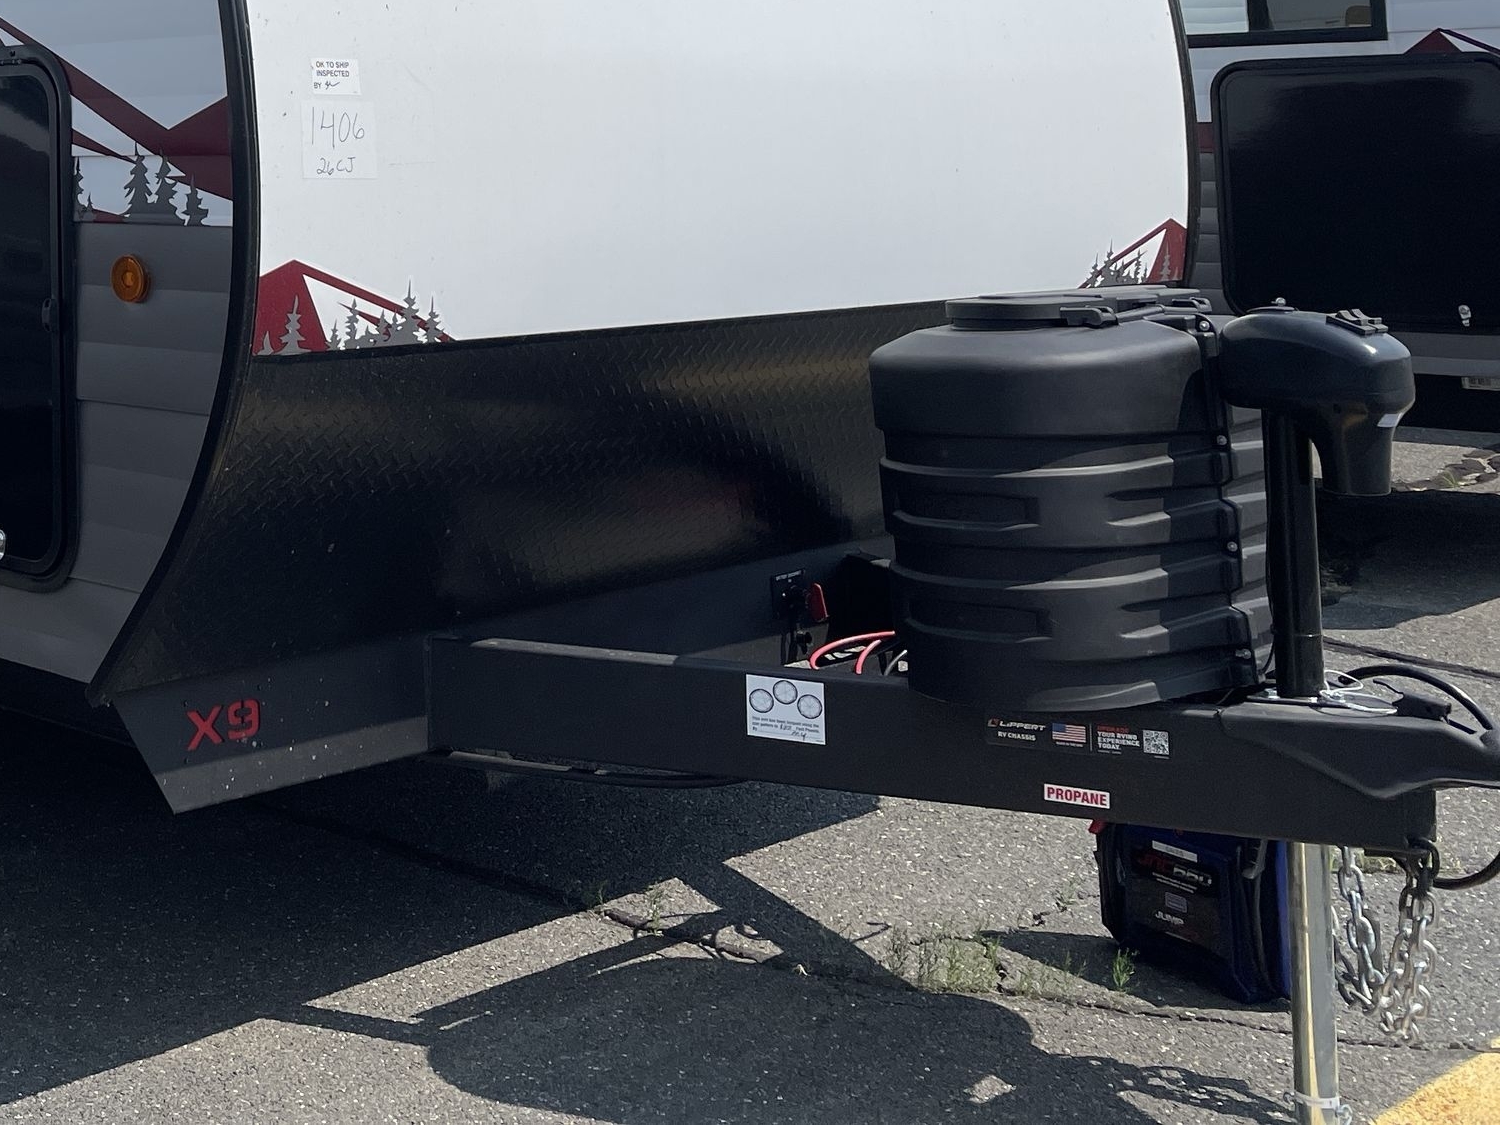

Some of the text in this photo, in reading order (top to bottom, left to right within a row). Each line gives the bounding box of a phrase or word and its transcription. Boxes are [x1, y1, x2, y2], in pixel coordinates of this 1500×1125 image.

[315, 61, 350, 69] OK TO SHIP
[316, 69, 350, 78] INSPECTED
[311, 106, 366, 150] 1406
[186, 698, 260, 752] X9
[999, 720, 1047, 732] LIPPERT
[1007, 732, 1037, 742] CHASSIS
[1097, 731, 1116, 739] YOUR
[1097, 737, 1141, 748] EXPERIENCE
[1046, 786, 1108, 807] PROPANE
